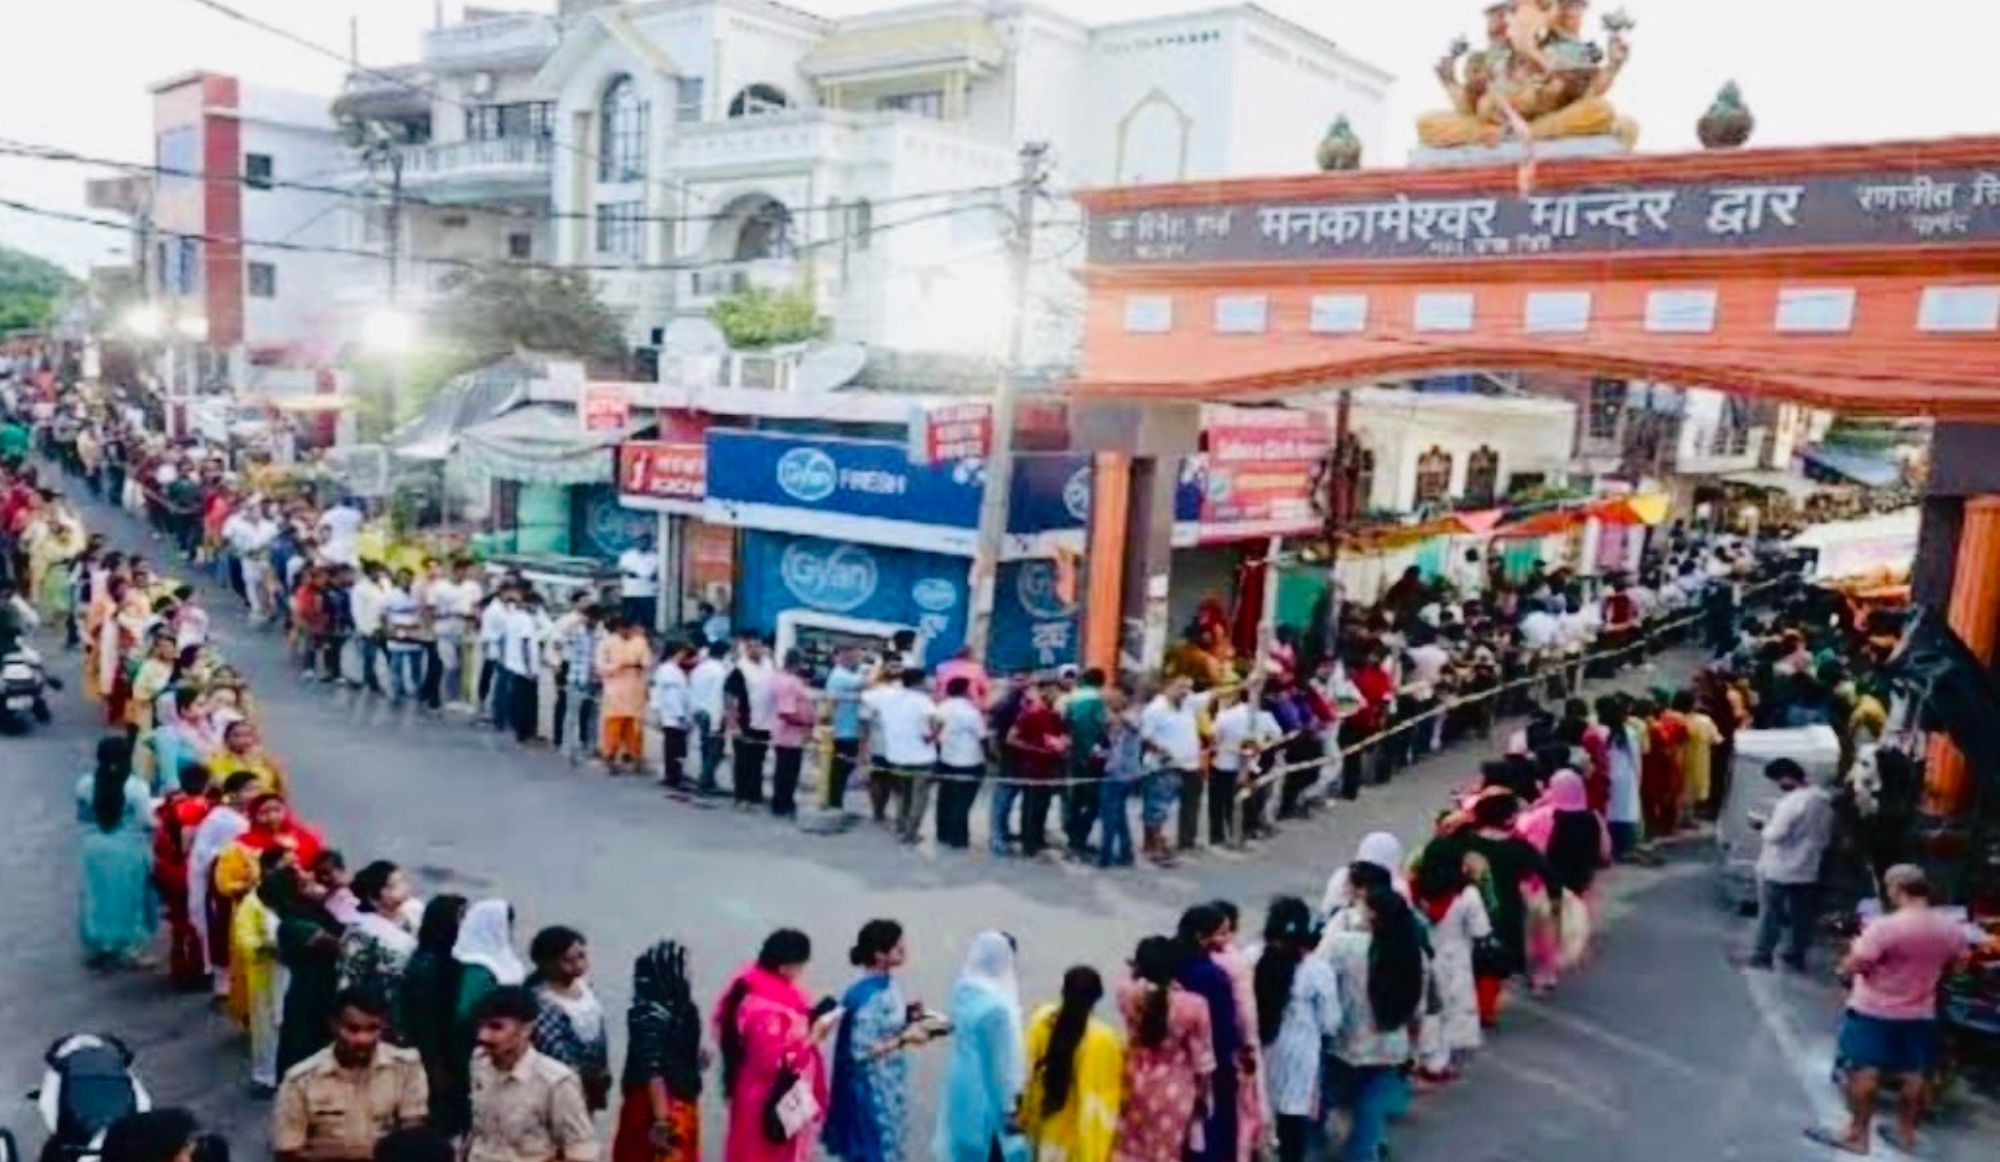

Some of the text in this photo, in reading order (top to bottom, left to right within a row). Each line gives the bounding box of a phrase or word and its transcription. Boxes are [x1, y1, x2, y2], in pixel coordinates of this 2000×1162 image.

[1257, 193, 1496, 243] मनकामेश्वर
[1706, 185, 1804, 234] द्वार
[788, 549, 870, 596] Gyan
